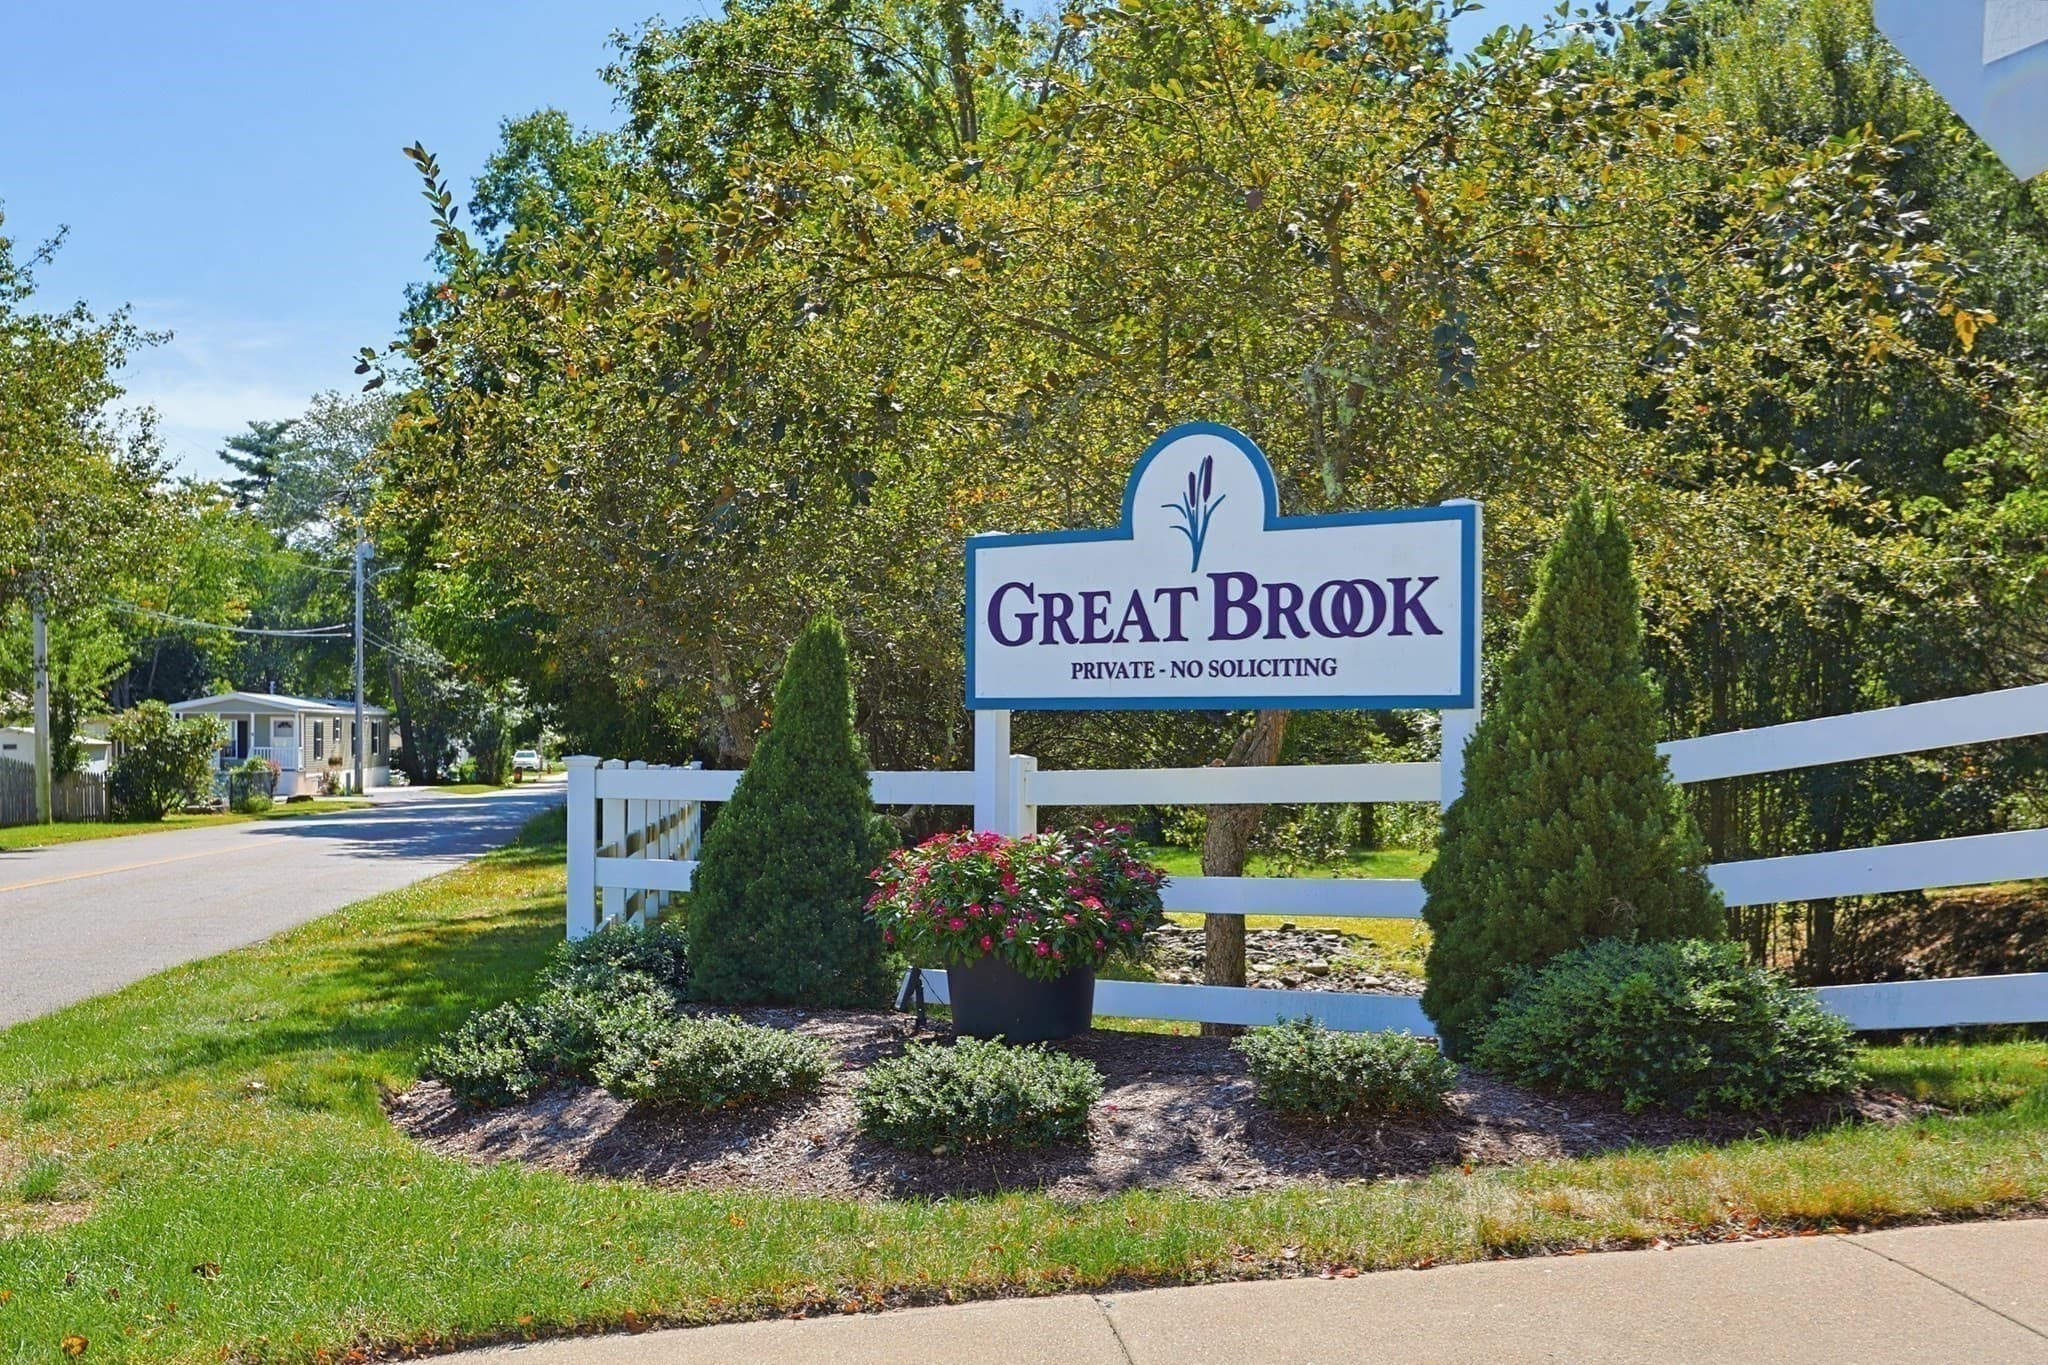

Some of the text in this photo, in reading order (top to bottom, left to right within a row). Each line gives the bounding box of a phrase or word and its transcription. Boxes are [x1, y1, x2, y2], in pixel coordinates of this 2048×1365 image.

[988, 572, 1443, 647] GREAT BROOK
[1071, 660, 1155, 680] PRIVATE
[1171, 660, 1203, 679] NO
[1209, 657, 1338, 678] SOLICITING
